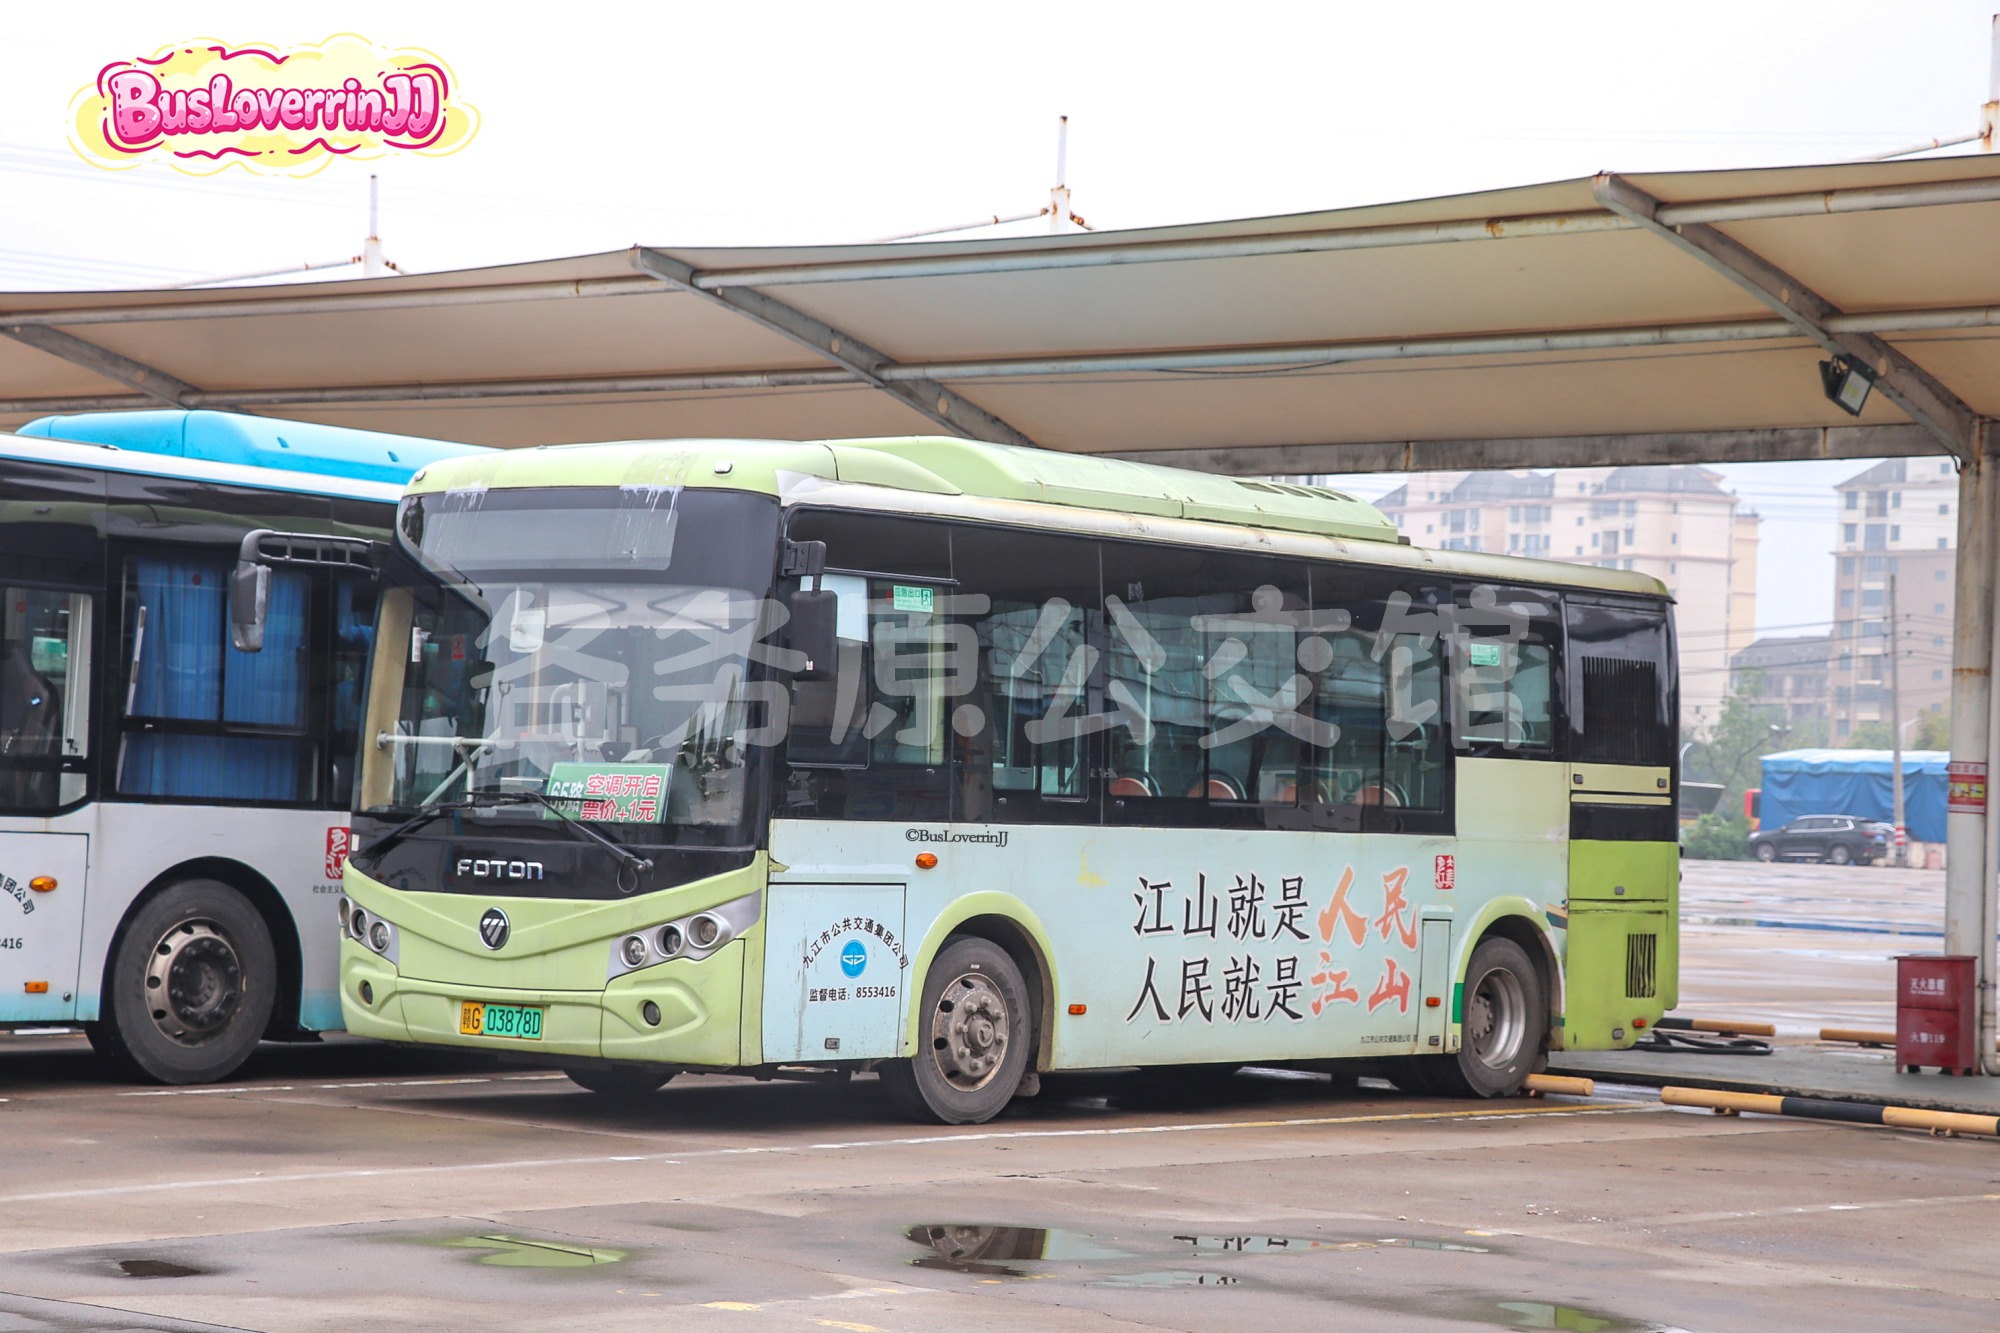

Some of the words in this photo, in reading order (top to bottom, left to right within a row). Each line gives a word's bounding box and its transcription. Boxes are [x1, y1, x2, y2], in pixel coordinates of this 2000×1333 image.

[549, 781, 584, 812] 65路
[584, 773, 662, 797] 空调开启
[581, 797, 657, 822] 票价+1元
[457, 859, 543, 880] FOTON
[1133, 866, 1418, 949] 江山就是人民
[803, 916, 909, 969] 九江市公共交通集团公司
[1126, 952, 1411, 1022] 人民就是江山
